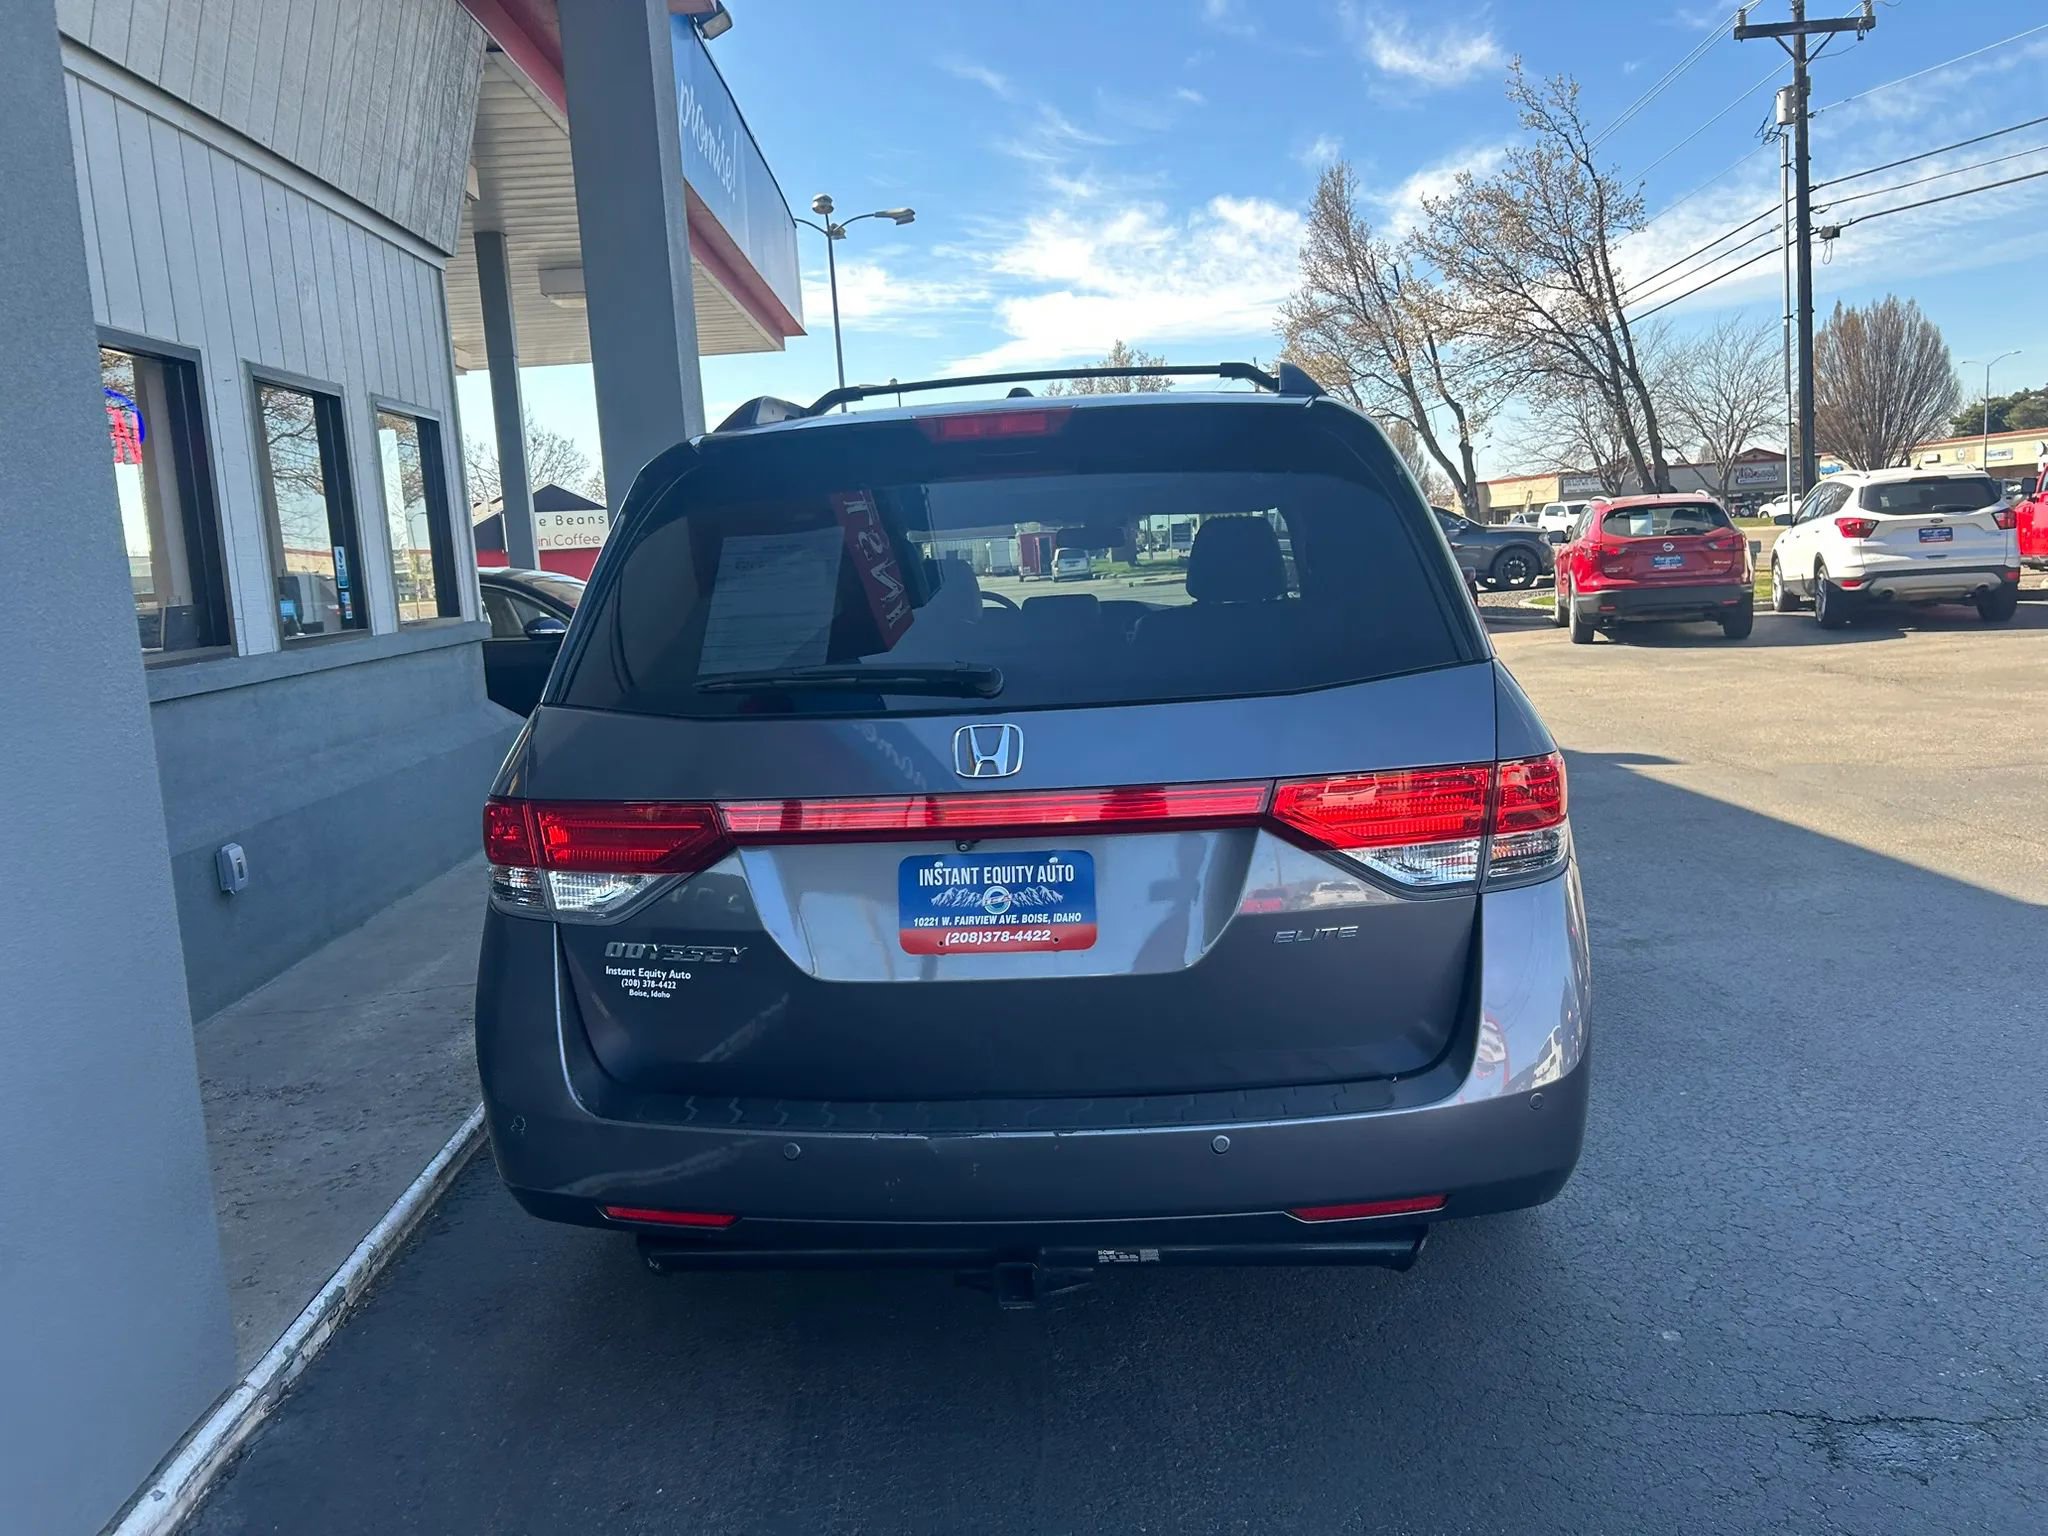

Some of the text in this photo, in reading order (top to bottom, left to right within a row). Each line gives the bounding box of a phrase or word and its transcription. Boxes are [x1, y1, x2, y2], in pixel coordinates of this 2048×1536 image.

[678, 80, 737, 203] promise!
[539, 515, 605, 526] e Beans
[537, 533, 601, 547] ini Coffee
[919, 864, 1075, 886] INSTANT EQUITY AUTO
[913, 912, 1082, 927] 10221 W. FAIRVIEW AVE. BOISE, IDAHO
[945, 929, 1051, 946] (208)378-4422
[1273, 925, 1359, 944] ELITE
[604, 941, 748, 963] ODYSSEY
[605, 965, 692, 980] Instant Equity Auto
[621, 978, 677, 989] (208) 378-4422
[629, 989, 671, 999] Boise, Idaho
